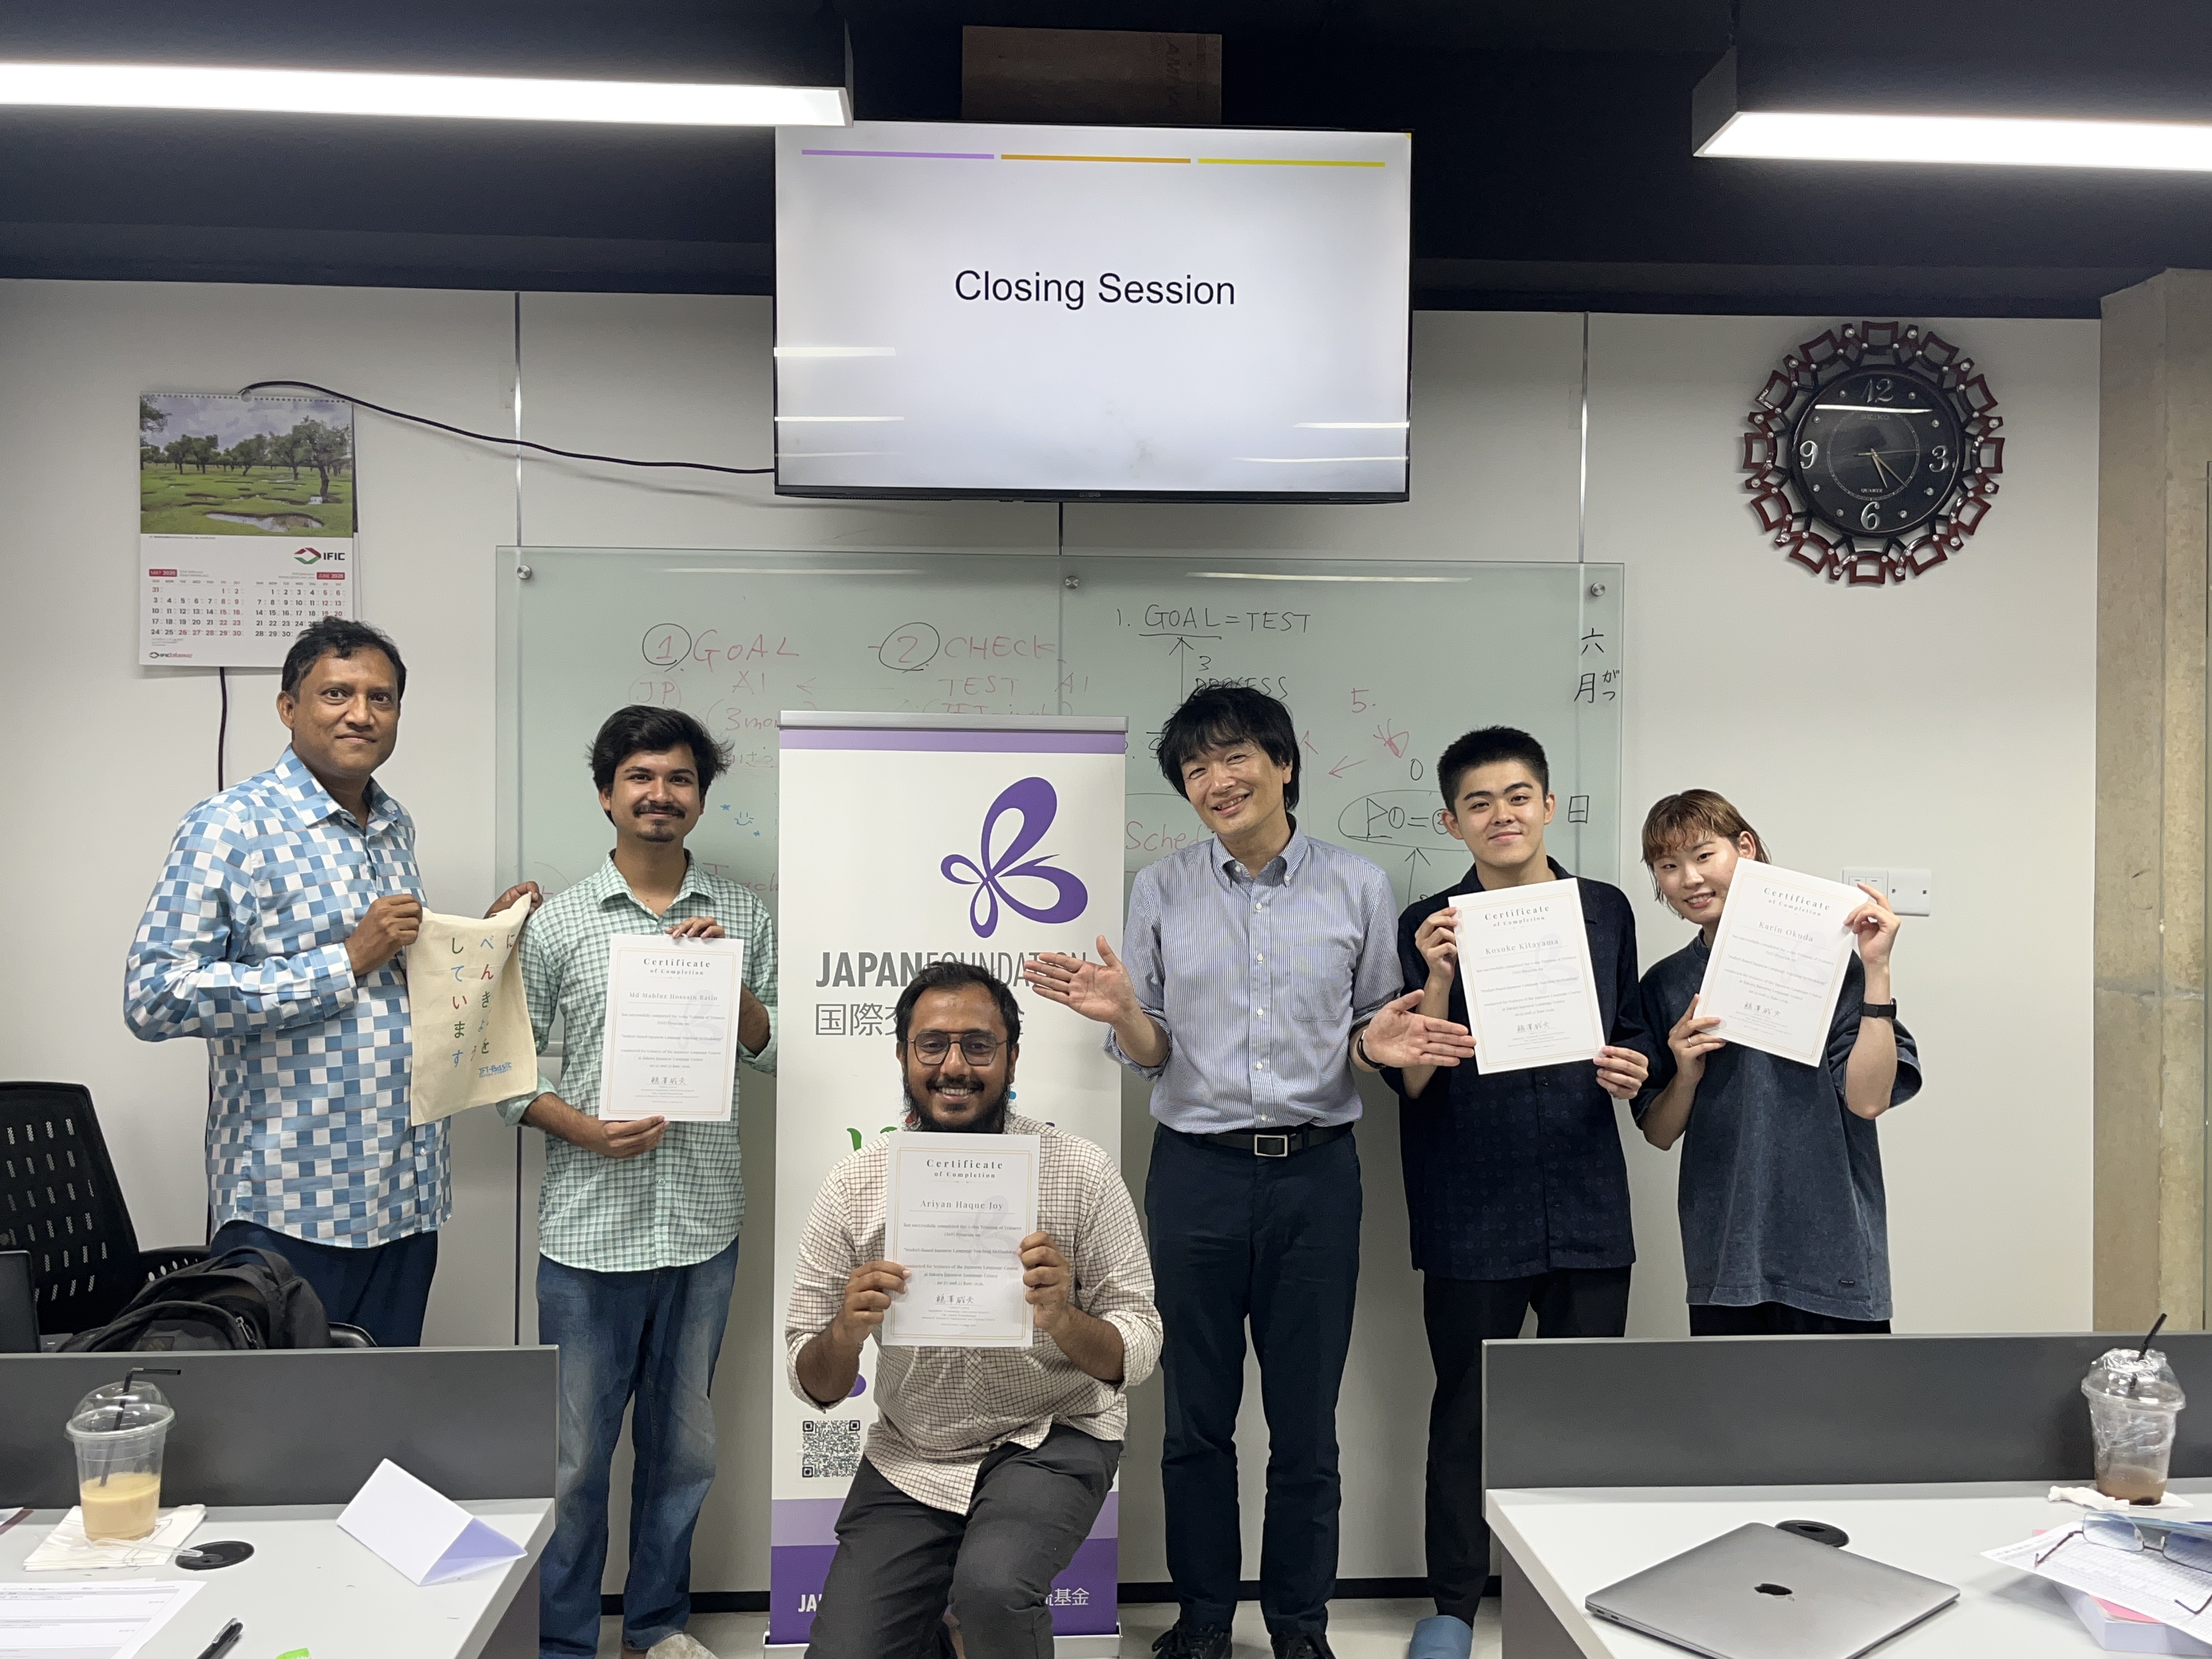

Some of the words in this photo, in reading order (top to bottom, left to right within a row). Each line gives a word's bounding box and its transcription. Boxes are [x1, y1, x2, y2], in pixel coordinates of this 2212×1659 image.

[955, 269, 1085, 311] Closing
[1098, 273, 1237, 306] Session
[1860, 378, 1894, 403] 12
[1799, 440, 1819, 470] 9
[1928, 445, 1950, 472] 3
[1860, 501, 1881, 531] 6
[323, 552, 346, 561] IFIC
[945, 634, 1056, 659] CHECK
[939, 677, 1019, 697] TEST
[1602, 669, 1620, 701] がつ
[1763, 887, 1831, 911] Certificate
[1484, 905, 1550, 921] Certificate
[1758, 921, 1783, 934] Karin
[1785, 928, 1814, 943] Okuda
[1485, 944, 1516, 955] Kosuke
[1519, 939, 1559, 950] Kitayama
[644, 957, 712, 968] Certificate
[450, 937, 468, 1068] しています
[926, 1159, 1003, 1170] Certificate
[920, 1200, 952, 1209] Ariyan
[956, 1200, 985, 1210] Haque
[989, 1201, 1003, 1211] Joy
[797, 1594, 822, 1613] JA
